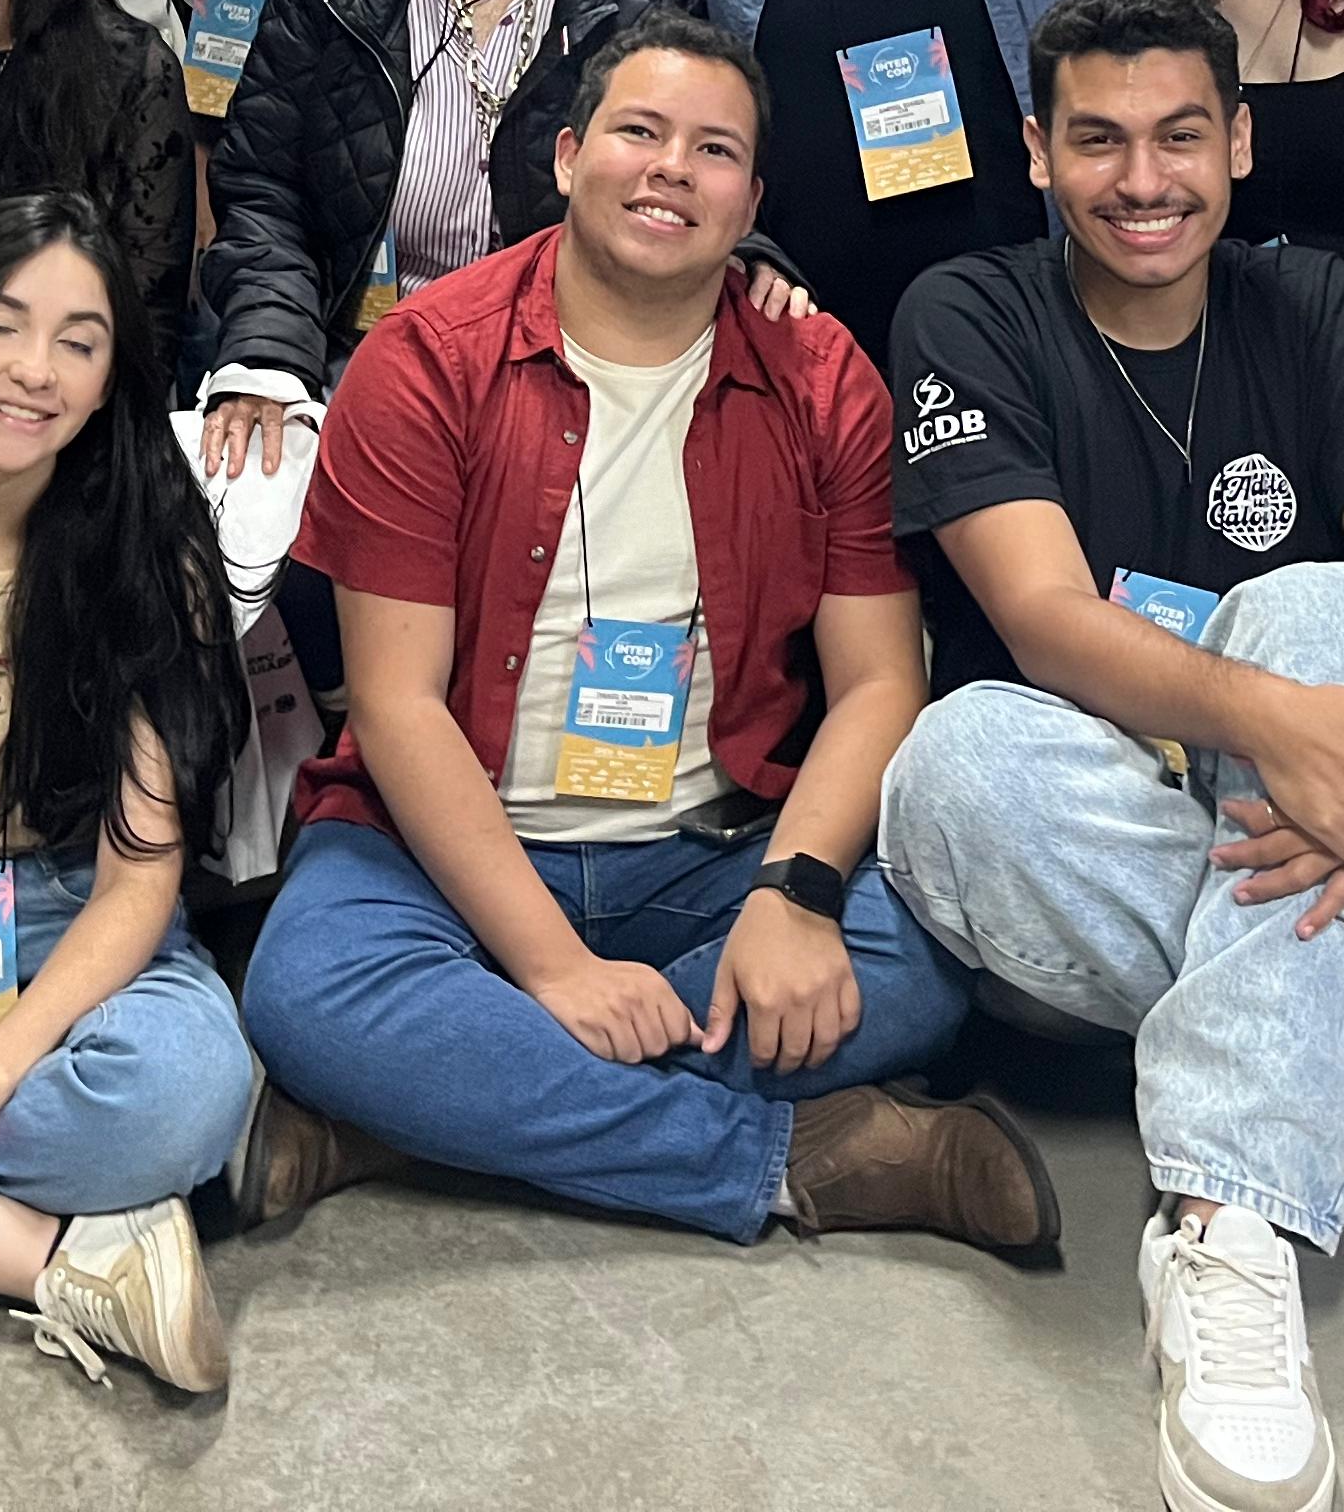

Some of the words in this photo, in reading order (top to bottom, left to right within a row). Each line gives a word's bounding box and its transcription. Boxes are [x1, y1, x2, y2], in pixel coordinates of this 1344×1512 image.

[875, 56, 909, 72] INTER
[886, 66, 912, 79] COM
[903, 409, 986, 454] UCDB
[1147, 602, 1185, 621] INTER
[1154, 615, 1184, 631] COM
[615, 643, 653, 656] INTER
[622, 654, 652, 667] COM
